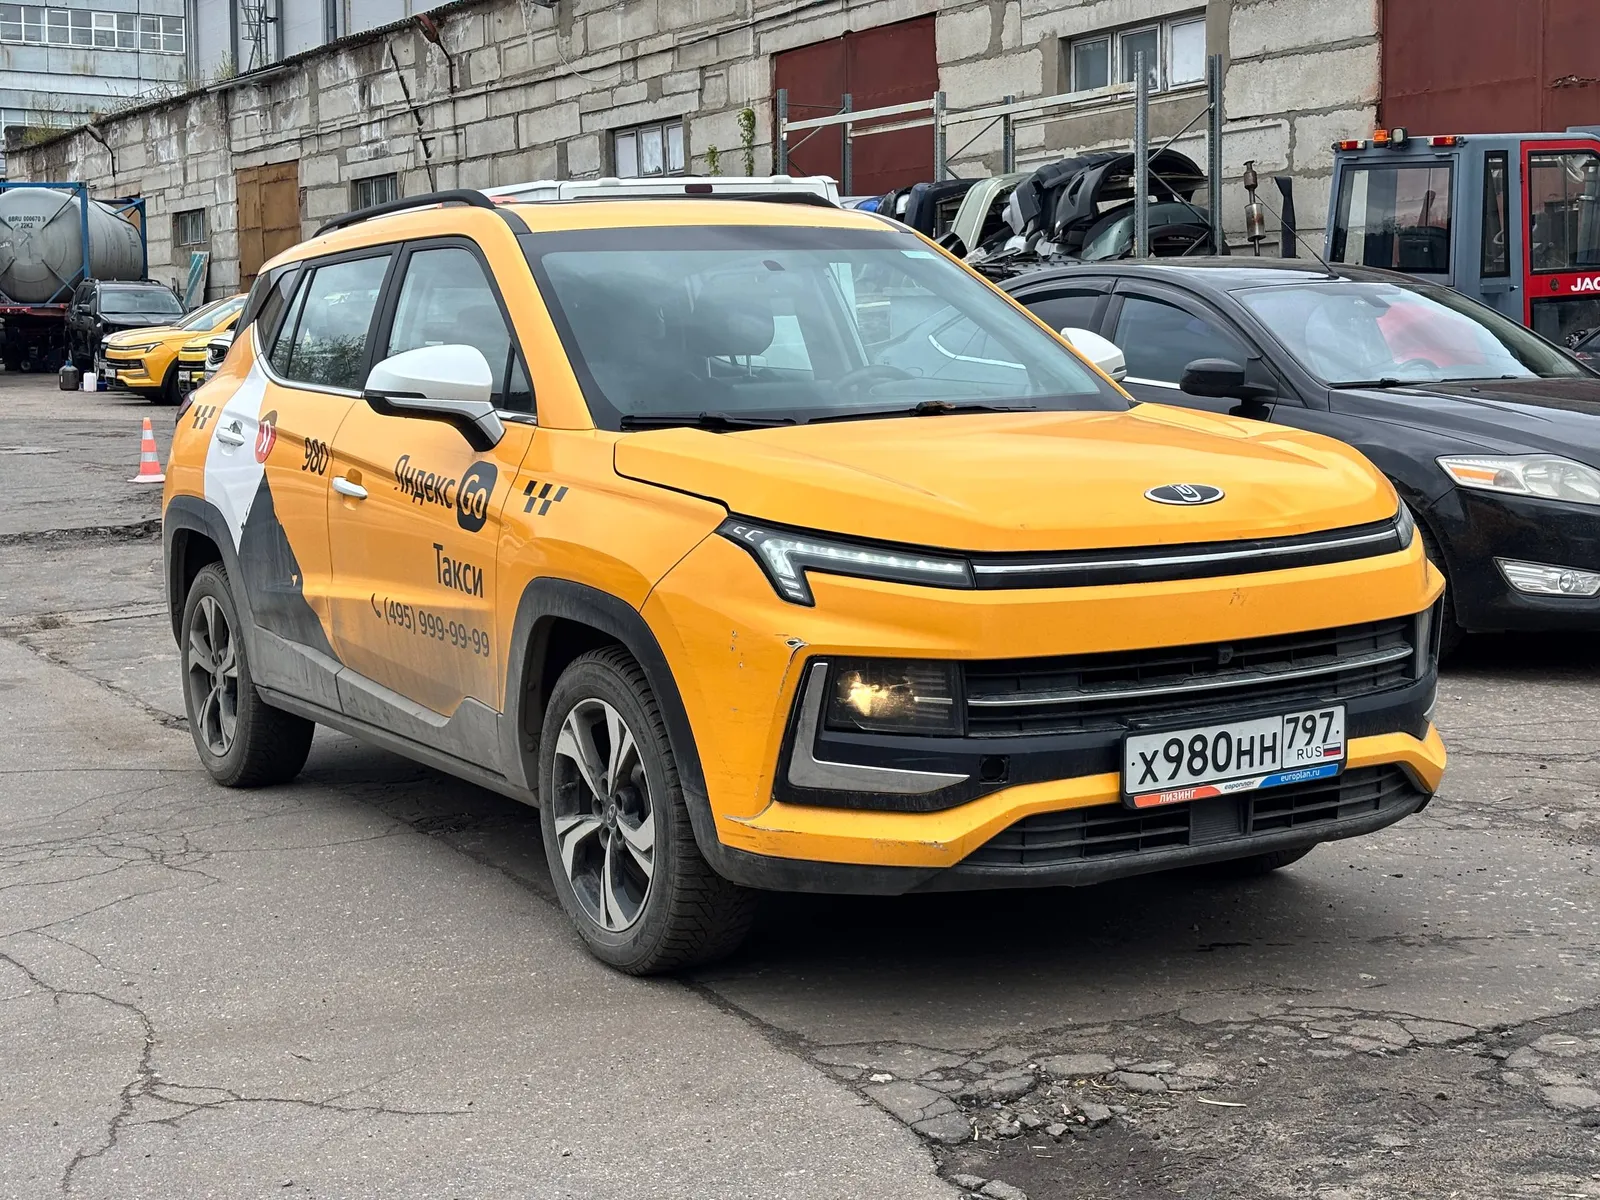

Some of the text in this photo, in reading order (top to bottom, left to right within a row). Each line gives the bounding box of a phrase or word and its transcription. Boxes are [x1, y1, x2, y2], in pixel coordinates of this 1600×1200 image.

[302, 437, 329, 476] 980
[394, 454, 487, 519] Яндекс Go
[433, 542, 484, 598] Такси
[383, 596, 490, 657] (495) 999-99-99
[1285, 711, 1335, 749] 797
[1296, 746, 1323, 760] RUS
[1280, 769, 1320, 783] europlan.ru
[1158, 789, 1197, 804] ЛИЗИНГ
